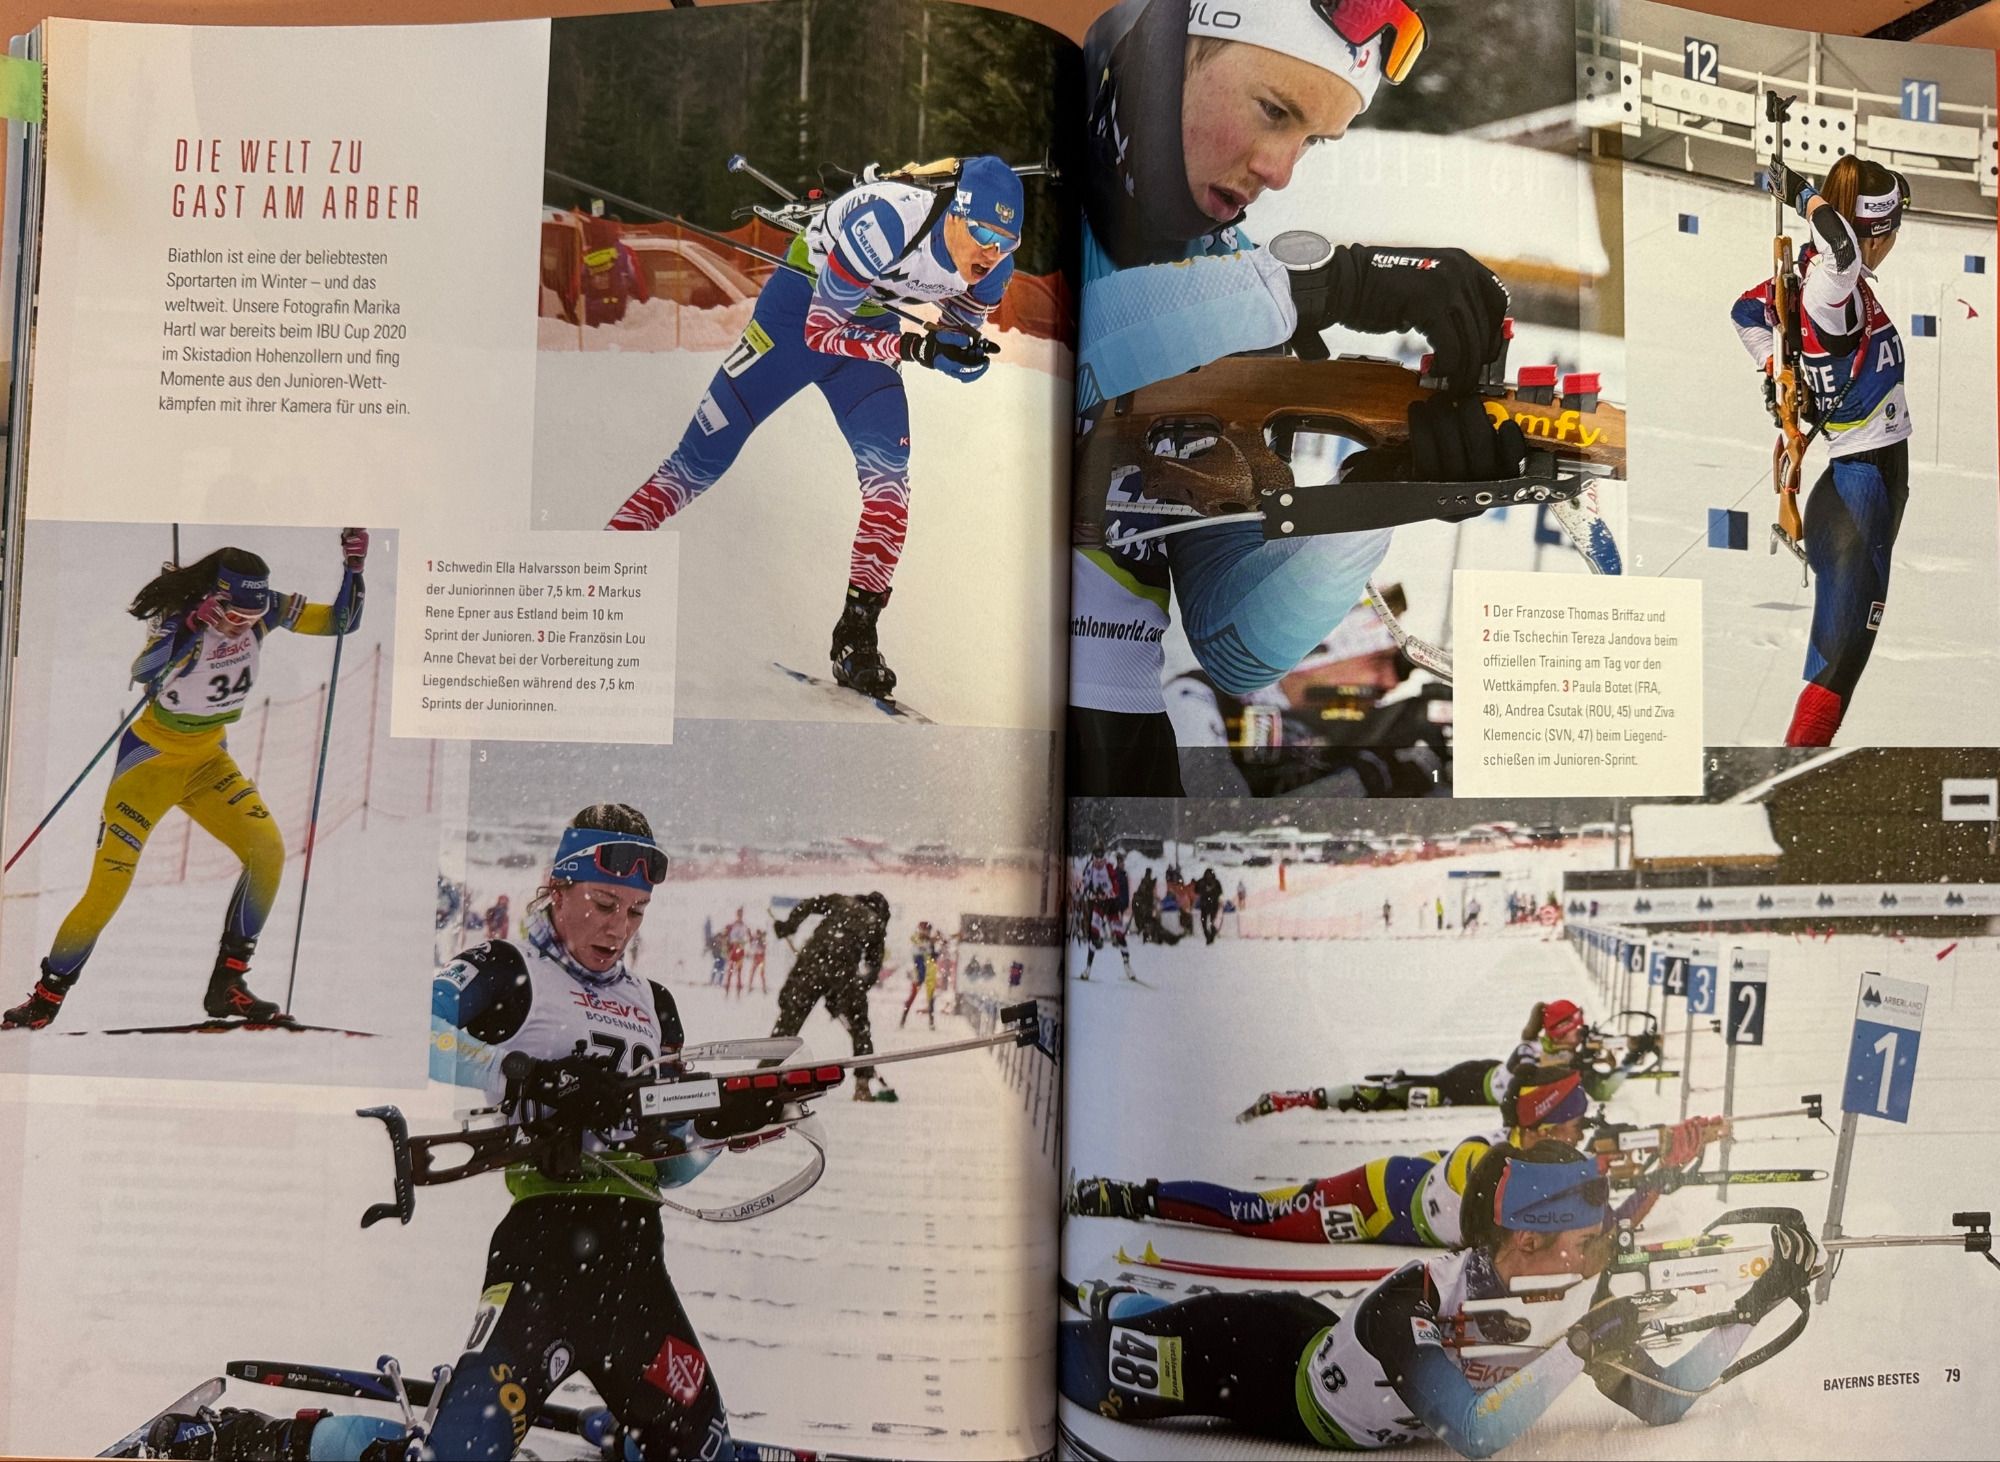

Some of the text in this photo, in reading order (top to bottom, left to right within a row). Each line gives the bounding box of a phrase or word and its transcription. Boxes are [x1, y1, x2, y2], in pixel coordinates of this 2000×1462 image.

[1686, 41, 1718, 85] 12
[1904, 81, 1939, 122] 11
[176, 139, 362, 174] DIE WELT ZU
[173, 184, 418, 219] GAST AM ARBER
[168, 248, 387, 264] Biathlon ist eine der beliebtesten
[166, 272, 376, 290] Sportarten im Winter und das
[165, 297, 400, 317] weltweit. Unsere Fotografin Marika
[164, 321, 406, 342] Hartl war bereits beim IBU Cup 2020
[163, 346, 399, 367] im Skistadion Hohenzollern und fing
[161, 371, 387, 389] Momente aus den Junioren-Wett-
[159, 396, 410, 414] kämpfen mit ihrer Kamera für uns ein.
[541, 509, 548, 521] 2
[385, 541, 390, 552] 1
[427, 560, 647, 577] 1 Schwedin Ella Halvarsson beim Sprint
[1636, 555, 1643, 567] 2
[427, 584, 641, 598] der Juniorinnen über 7,5 km. 2 Markus
[426, 606, 623, 621] Rene Epner aus Estland beim 10 km
[1484, 604, 1665, 622] 1 Der Franzose Thomas Briffaz und
[425, 628, 645, 644] Sprint der Junioren. 3 Die Französin Lou
[1483, 629, 1677, 646] 2 die Tschechin Tereza Jandova beim
[424, 651, 639, 669] Anne Chevat bei der Vorbereitung zum
[1484, 654, 1661, 671] offiziellen Training am Tag vor den
[206, 666, 253, 702] 34
[423, 674, 634, 691] Liegendschießen während des 7,5 km
[1483, 679, 1660, 694] Wettkämpfen. 3 Paula Botet (FRA,
[422, 697, 556, 711] Sprints der Juniorinnen.
[1483, 704, 1674, 718] 48), Andrea Csutak (ROU, 45) und Ziva
[1484, 728, 1667, 744] Klemencic (SVN, 47) beim Liegend-
[480, 750, 487, 762] 3
[1483, 753, 1637, 768] schießen im Junioren-Sprint.
[1711, 759, 1718, 771] 3
[1432, 769, 1438, 783] 1
[1631, 946, 1643, 971] 6
[1652, 954, 1666, 985] 5
[1667, 959, 1684, 995] 4
[1693, 967, 1711, 1012] 3
[1736, 985, 1757, 1043] 2
[1873, 1031, 1899, 1114] 1
[733, 1194, 775, 1219] LARSEN
[1327, 1210, 1360, 1241] 45
[1112, 1331, 1159, 1390] 48
[1824, 1372, 1919, 1391] BAYERNS BESTES
[1945, 1368, 1960, 1382] 79
